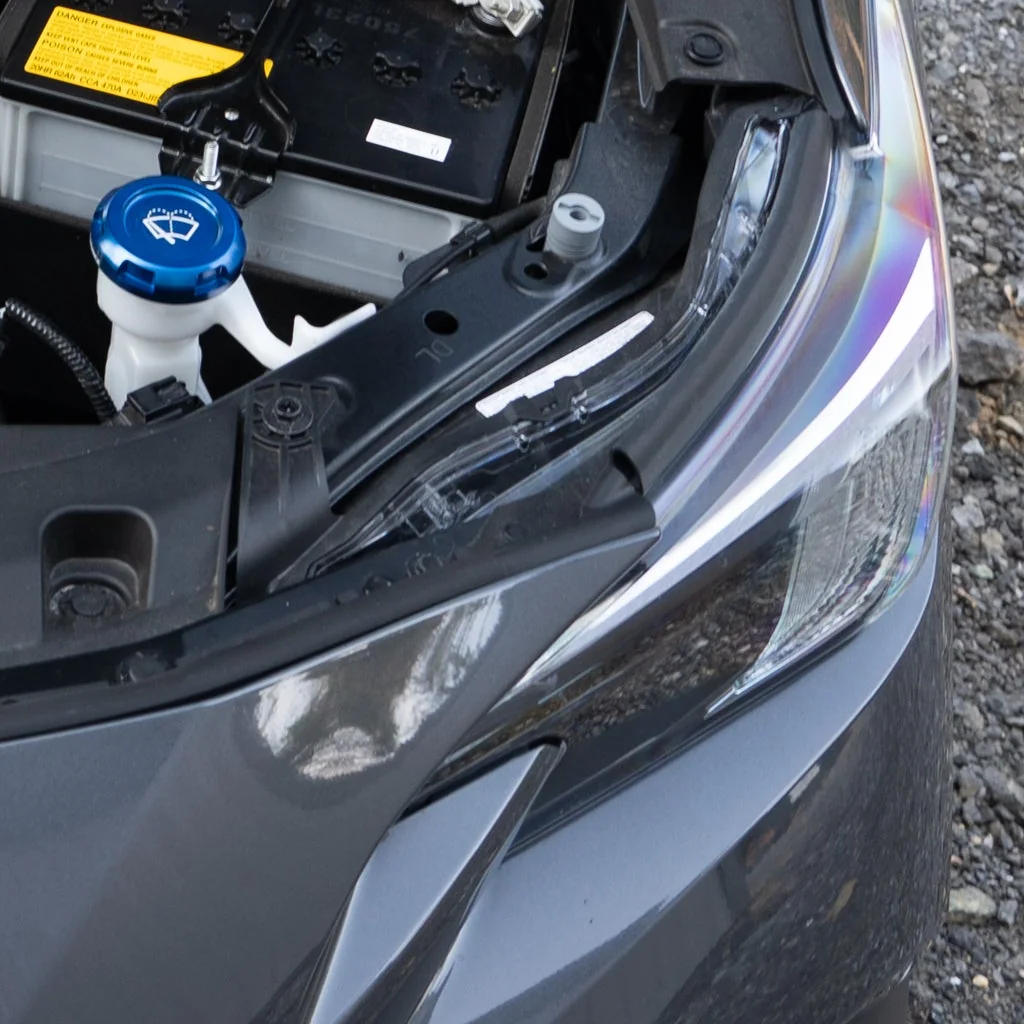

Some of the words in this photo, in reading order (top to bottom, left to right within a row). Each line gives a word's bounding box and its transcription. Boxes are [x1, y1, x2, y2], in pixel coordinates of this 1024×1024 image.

[56, 10, 98, 26] DANGER
[41, 39, 83, 55] POISON
[79, 76, 99, 87] CCA
